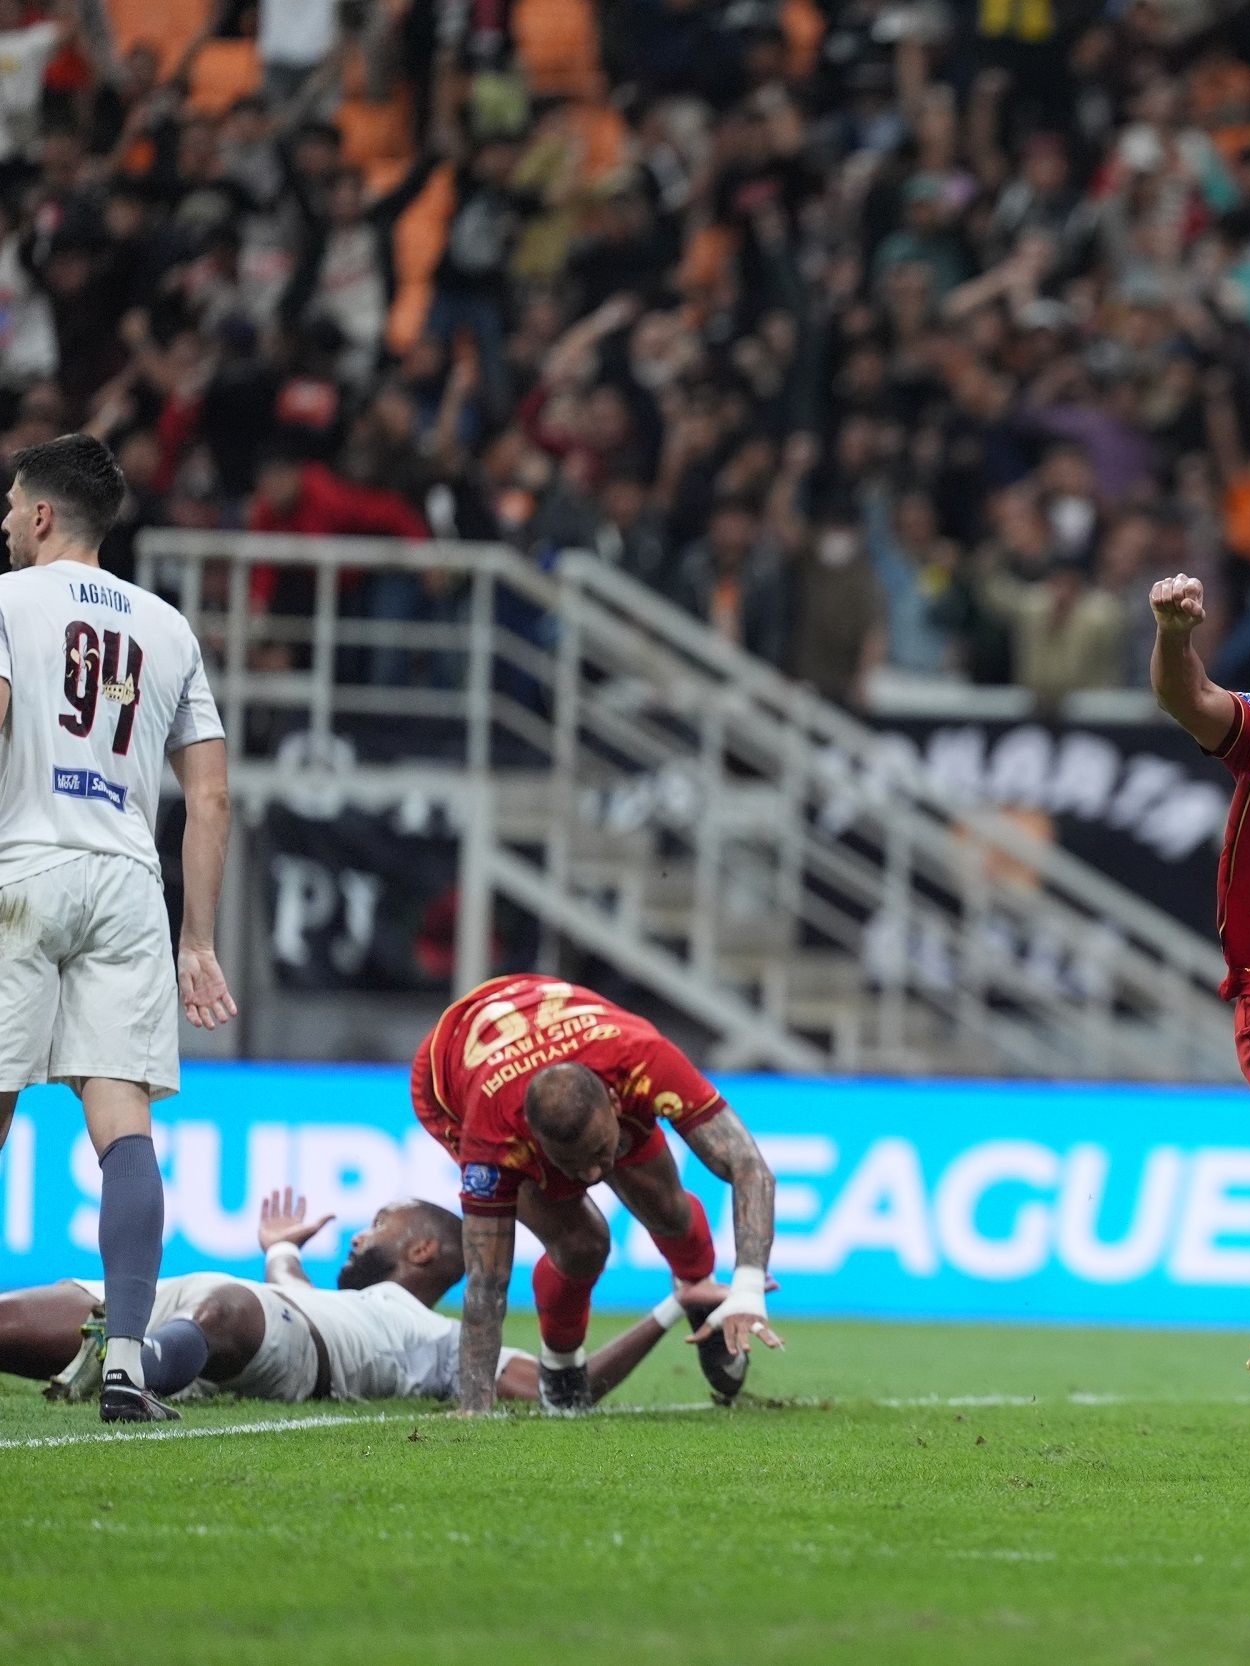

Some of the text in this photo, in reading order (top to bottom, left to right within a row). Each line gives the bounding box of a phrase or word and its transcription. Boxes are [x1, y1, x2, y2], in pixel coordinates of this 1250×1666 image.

[68, 583, 132, 614] LAGATOR
[58, 620, 144, 756] 94
[463, 981, 608, 1071] 70
[480, 1038, 580, 1099] HYUNDAI
[106, 1372, 123, 1380] KING
